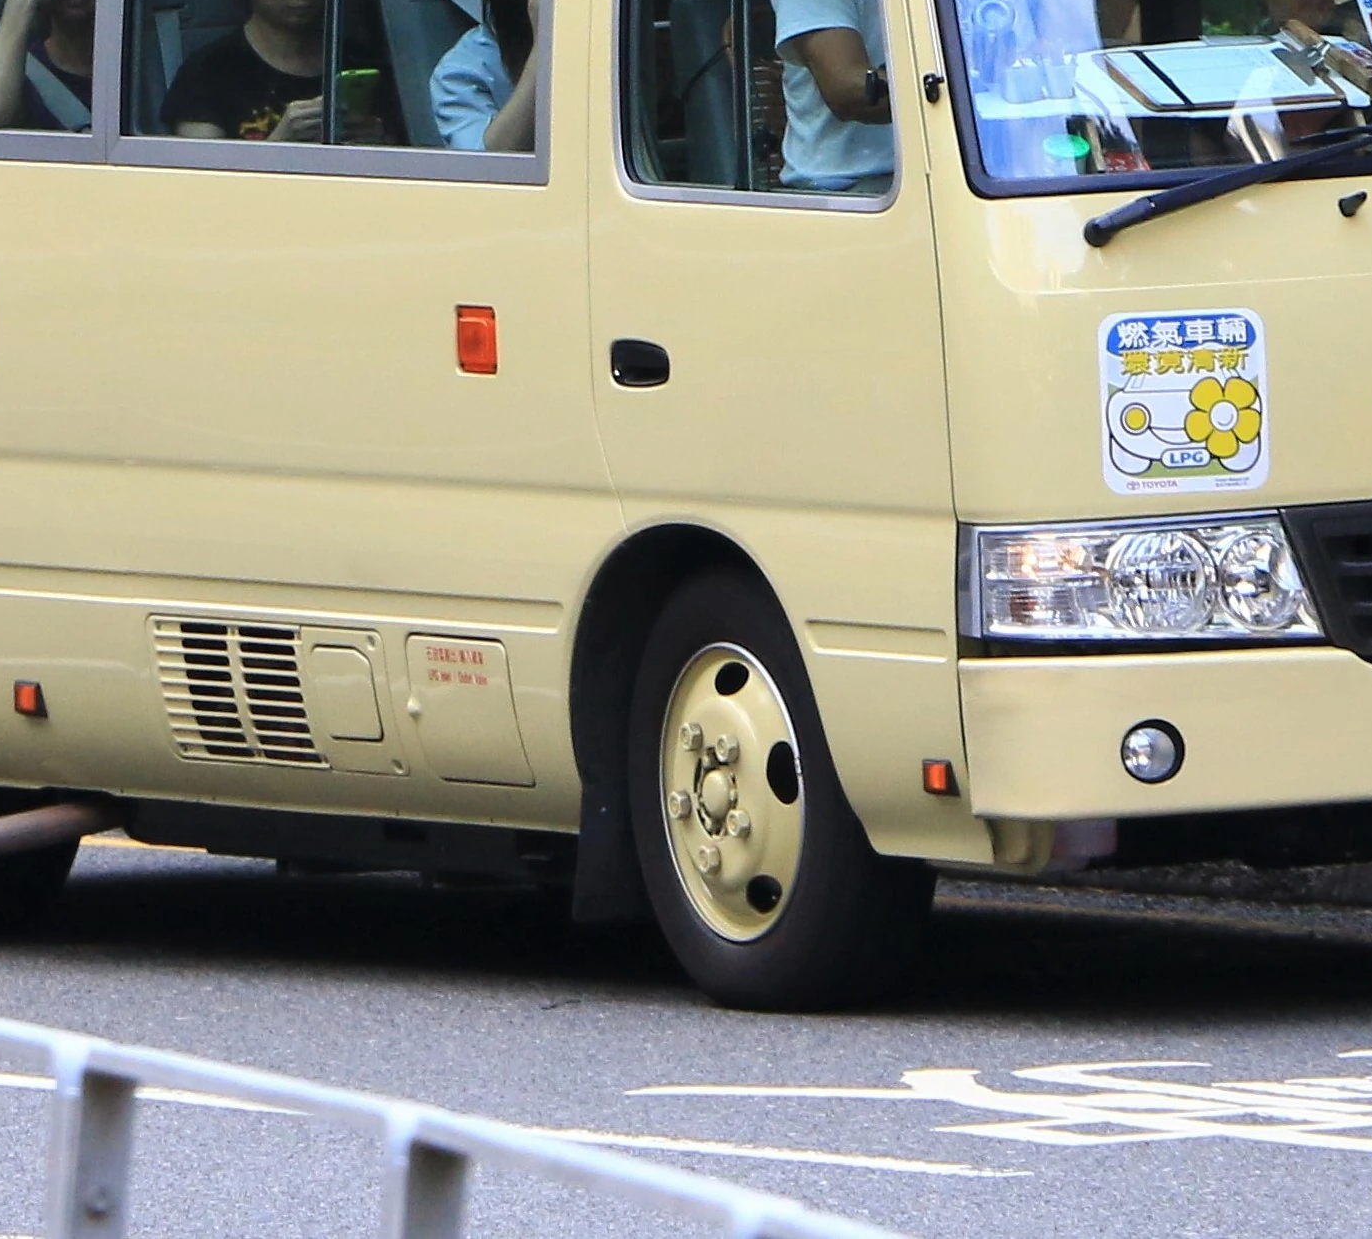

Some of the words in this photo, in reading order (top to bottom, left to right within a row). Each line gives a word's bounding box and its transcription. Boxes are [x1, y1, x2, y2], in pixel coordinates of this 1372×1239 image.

[1117, 317, 1247, 349] 燃氣車輛
[1169, 451, 1205, 465] LPG
[1141, 479, 1179, 490] TOYOTA
